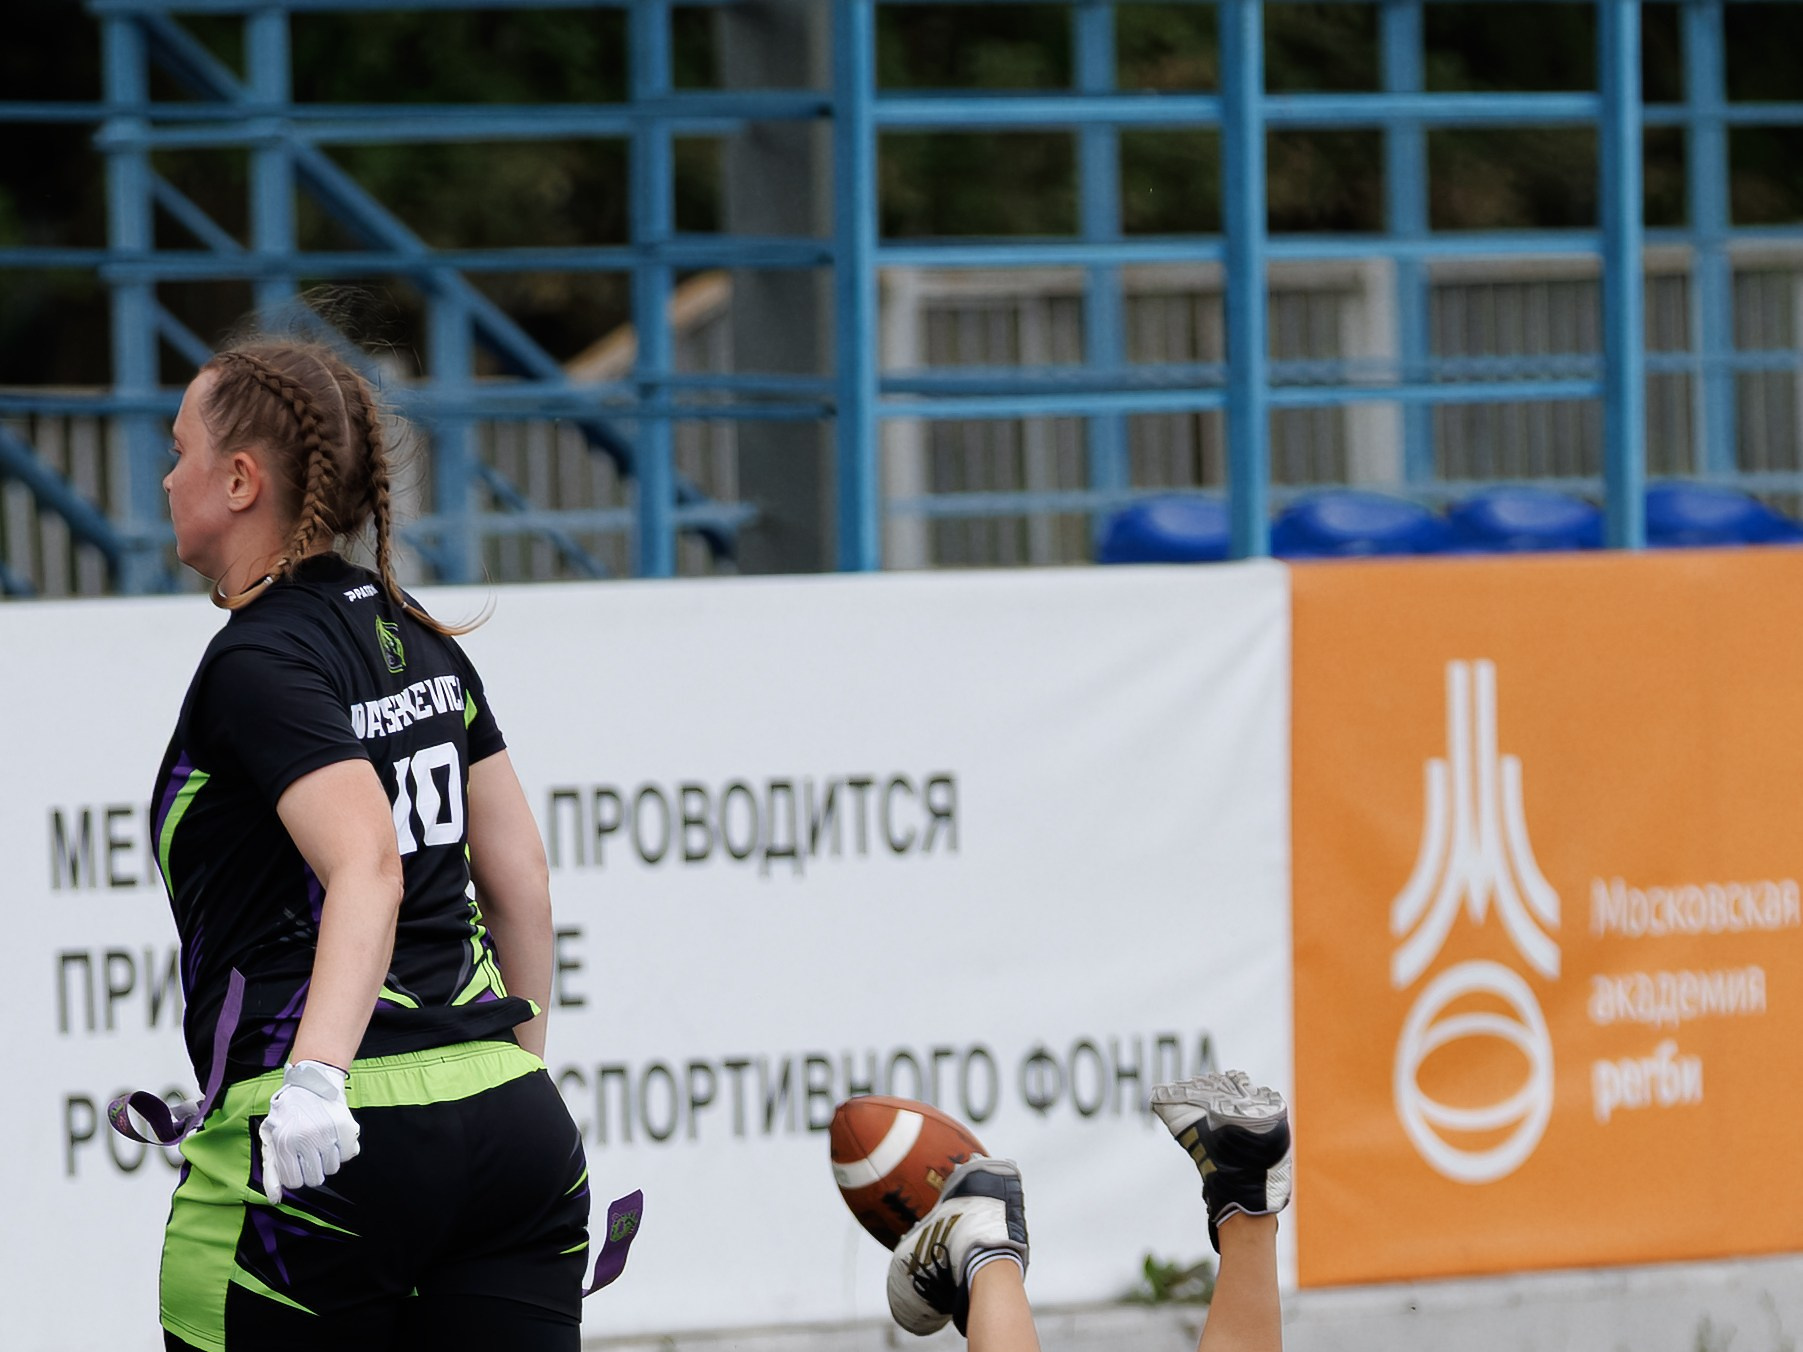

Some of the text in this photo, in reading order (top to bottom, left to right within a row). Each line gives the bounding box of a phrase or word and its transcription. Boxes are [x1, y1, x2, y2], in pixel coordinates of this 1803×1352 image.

[350, 675, 465, 740] DASHKEVIC
[393, 742, 463, 855] 10
[547, 773, 960, 878] ПРОВОДИТСЯ
[1590, 876, 1800, 938] Московская
[1588, 966, 1767, 1030] академия
[1592, 1037, 1704, 1125] регби
